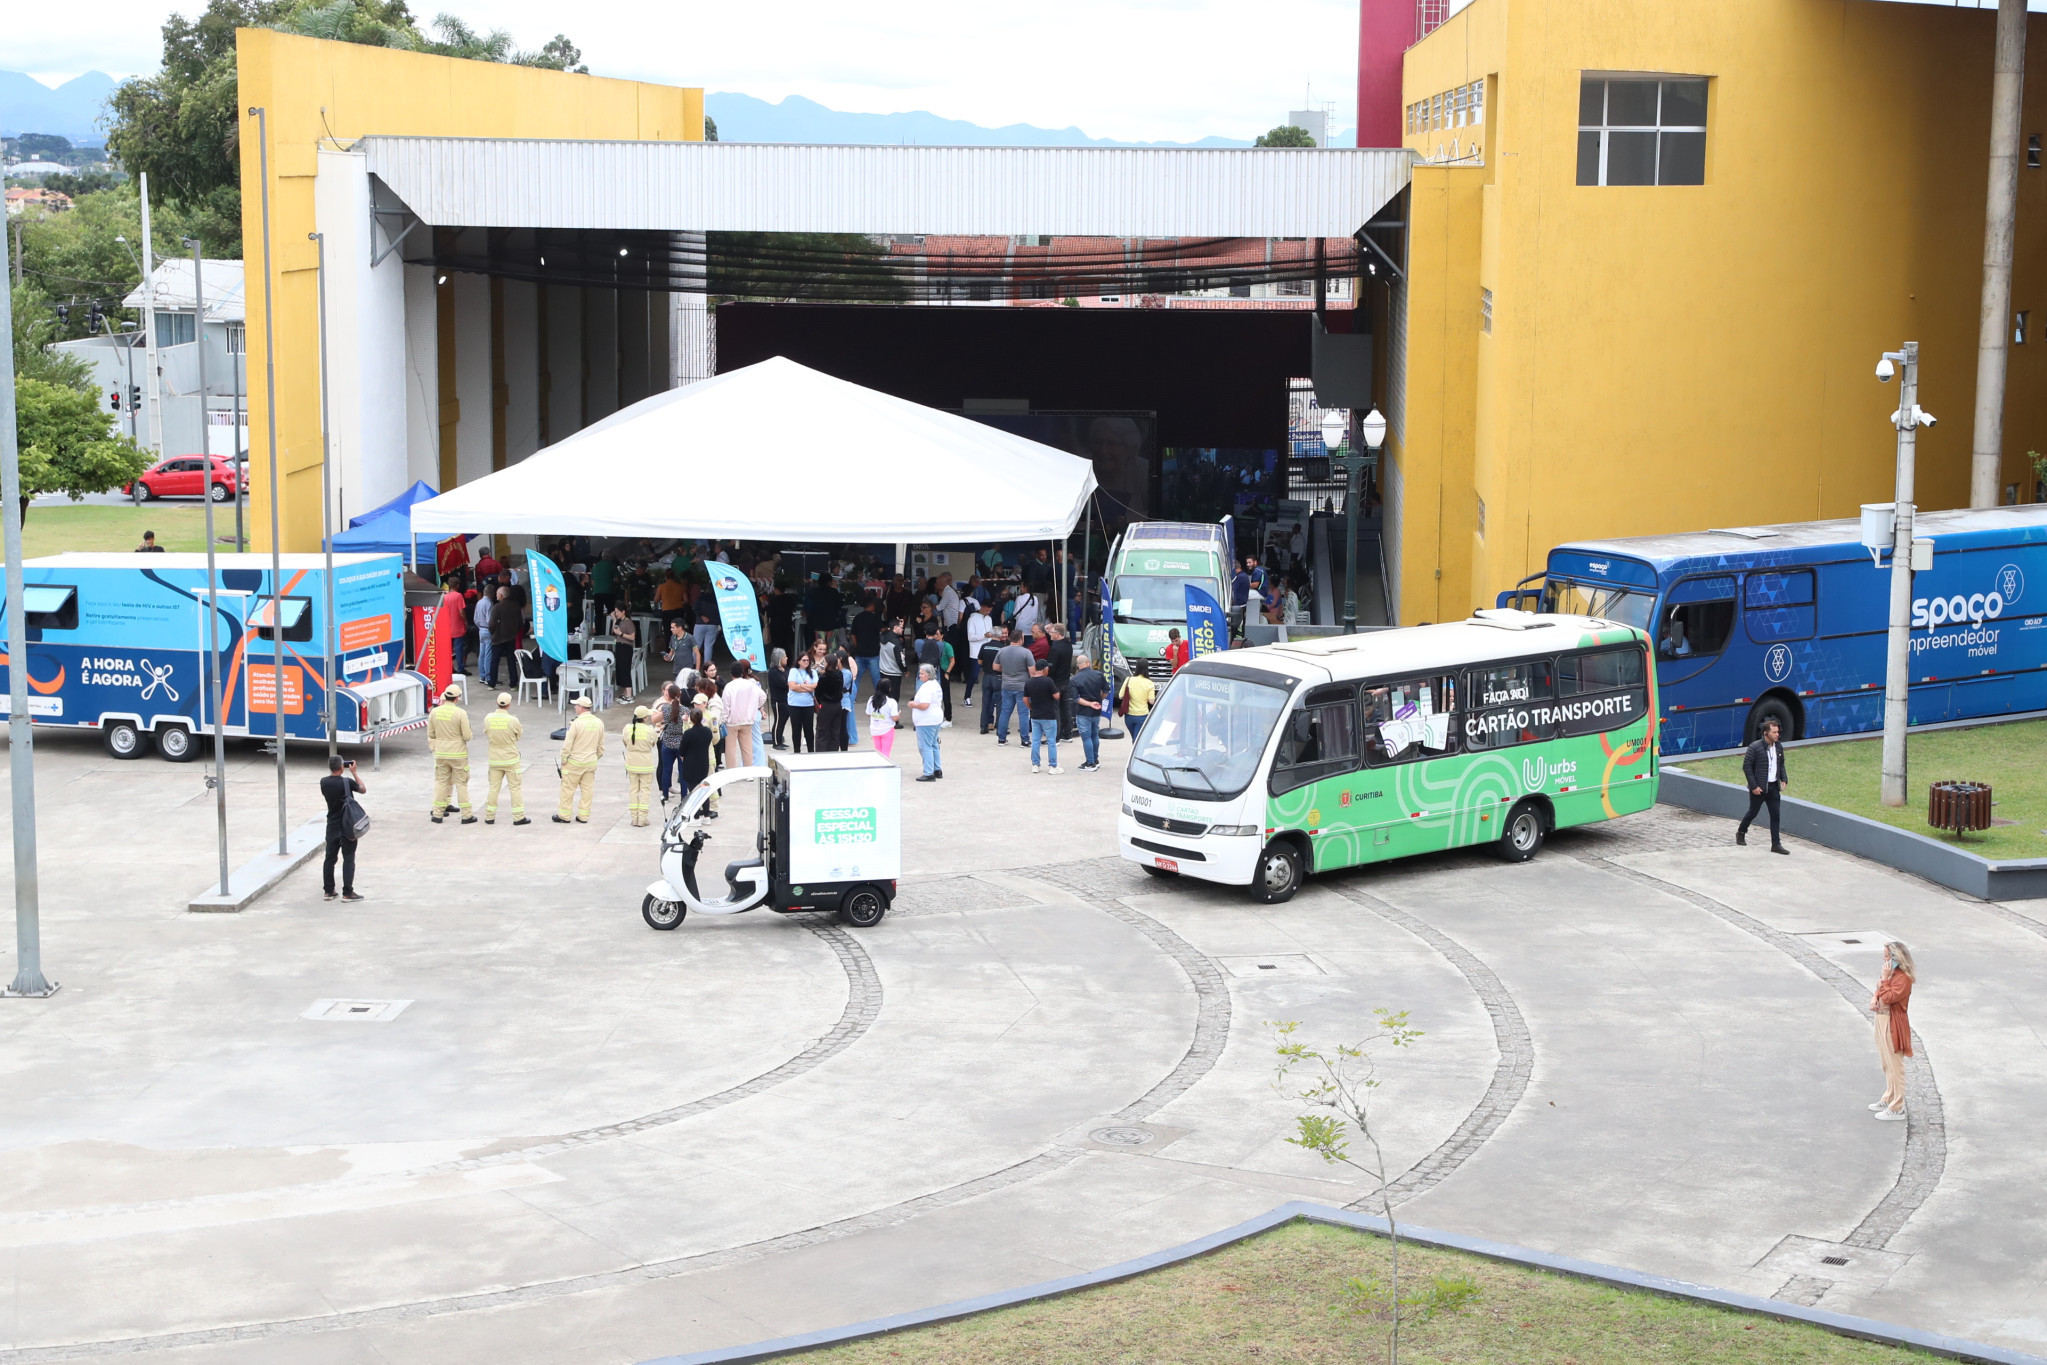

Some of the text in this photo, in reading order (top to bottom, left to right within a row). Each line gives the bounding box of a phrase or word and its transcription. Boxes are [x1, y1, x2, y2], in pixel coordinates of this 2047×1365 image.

[1189, 605, 1212, 614] SMDEI
[1912, 591, 2003, 634] spaço
[1195, 628, 1204, 657] URA
[1908, 627, 1999, 656] mpreendedor
[1103, 623, 1111, 686] ROCURA
[1968, 644, 1998, 657] móvel
[81, 657, 135, 671] A HORA
[81, 670, 143, 687] É AGORA
[1483, 690, 1510, 704] FAÇA
[1465, 695, 1632, 736] CARTÃO TRANSPORTE
[1627, 738, 1647, 747] UM001
[1550, 759, 1577, 775] urbs
[1555, 775, 1576, 784] MÓVEL
[1131, 794, 1152, 807] UM001
[1355, 791, 1383, 801] CURITIBA
[1176, 812, 1213, 823] TRANSPORTE
[817, 821, 874, 832] ESPECIAL
[819, 832, 872, 843] ÀS 15H30
